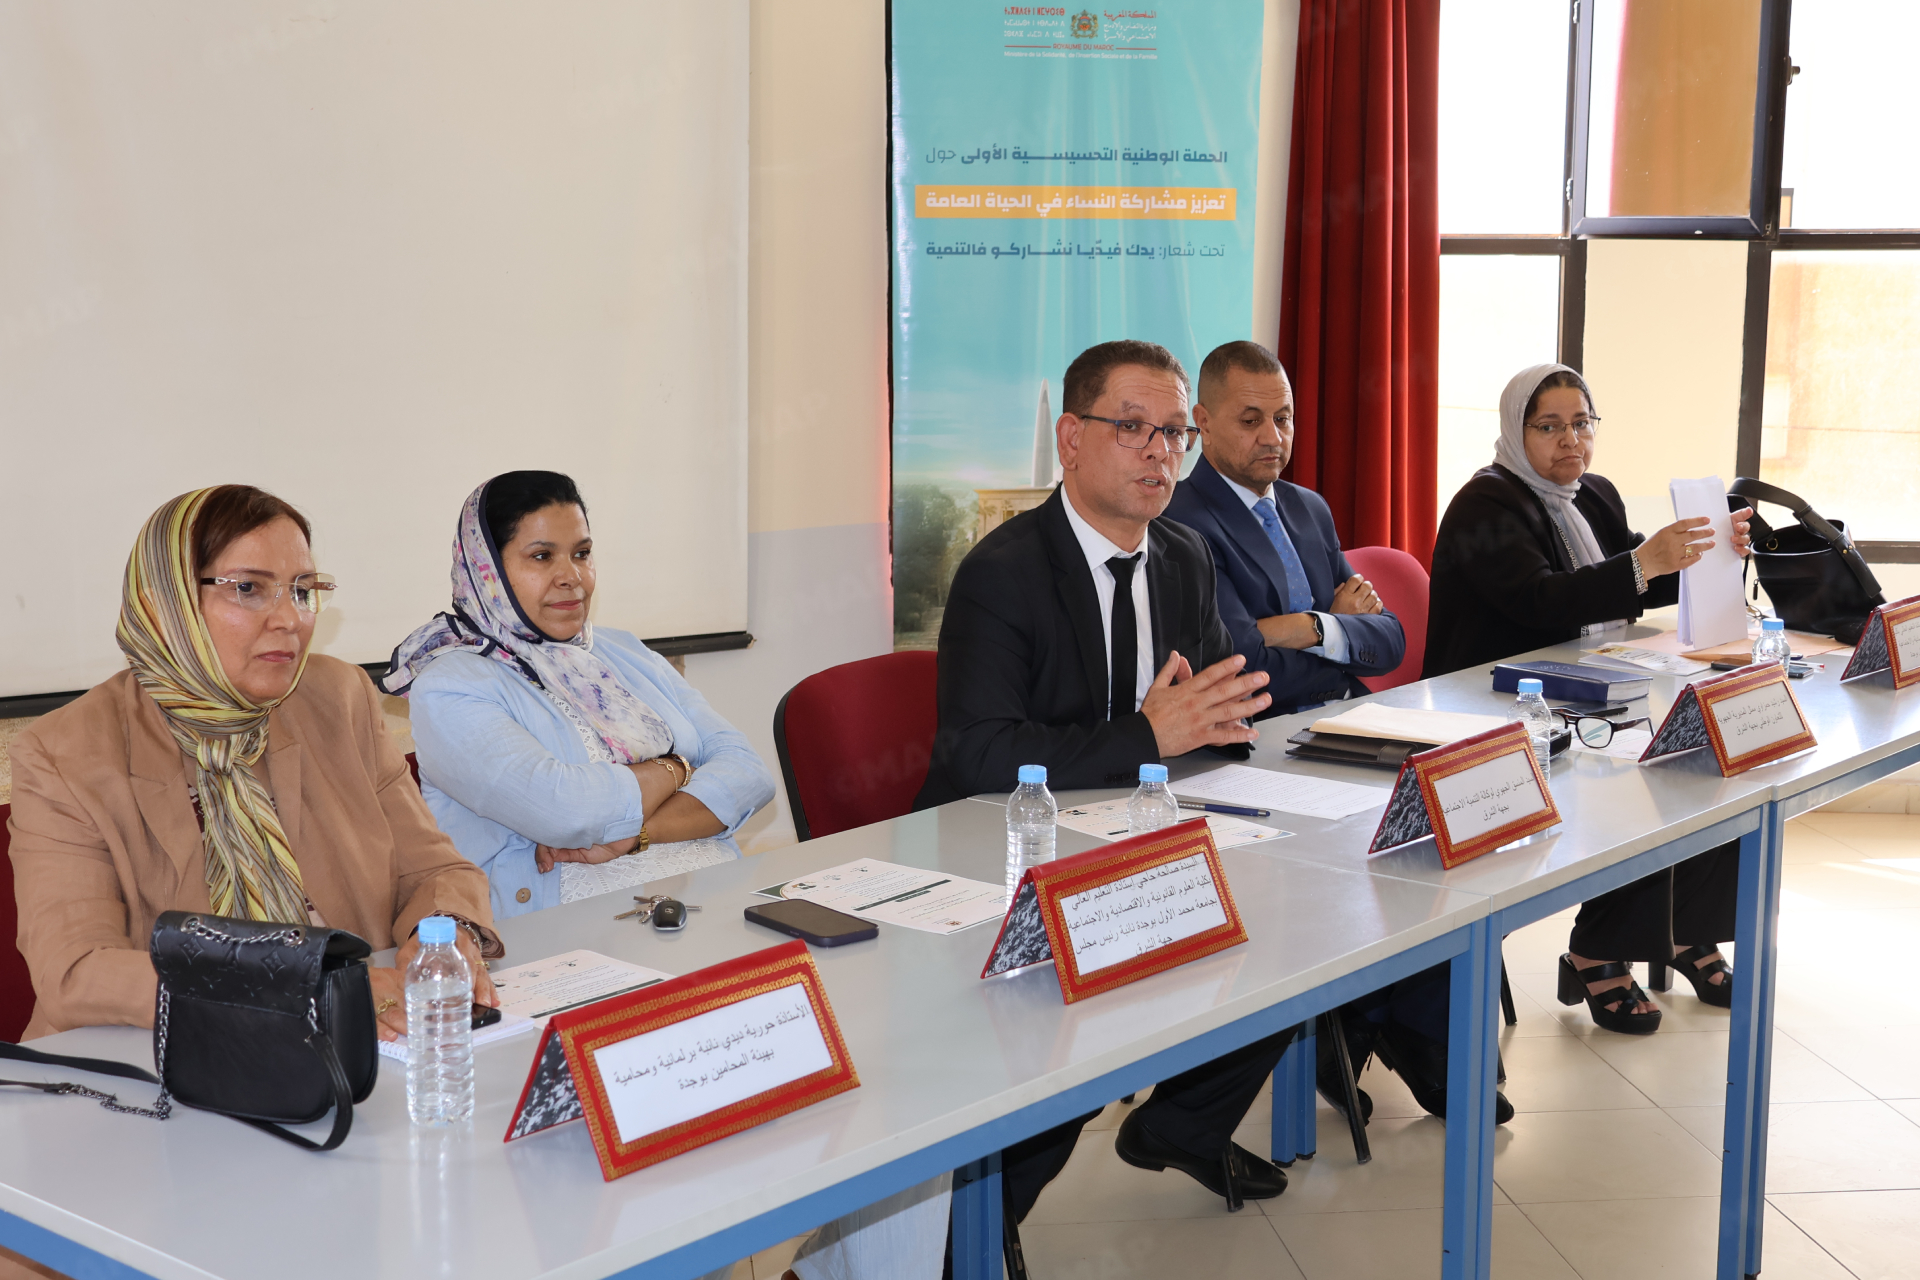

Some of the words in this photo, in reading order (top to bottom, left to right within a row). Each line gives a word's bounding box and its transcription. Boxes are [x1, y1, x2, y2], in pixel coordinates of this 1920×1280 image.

[1103, 9, 1128, 22] المغربية
[1128, 9, 1157, 19] المملكة
[925, 145, 957, 164] حول
[961, 142, 1008, 165] الأولى
[1122, 146, 1179, 166] الوطنية
[1183, 147, 1228, 164] الحملة
[925, 192, 981, 208] العامة
[984, 191, 1032, 213] الحياة
[1036, 193, 1063, 217] في
[1065, 195, 1116, 210] النساء
[1119, 189, 1187, 214] مشاركة
[1190, 194, 1227, 215] تعزيز
[925, 241, 987, 260] فالتنمية
[1125, 243, 1155, 260] يدك
[1158, 240, 1195, 260] شعار:
[1199, 243, 1226, 258] تحت
[1495, 781, 1511, 799] الجهوي
[1482, 805, 1498, 822] الشرق
[1497, 804, 1510, 815] بجهة
[1156, 864, 1179, 878] صالحة
[1179, 856, 1199, 872] السيدة
[1137, 871, 1156, 889] حاجي
[1178, 879, 1196, 898] العلوم
[1196, 873, 1212, 889] بكلية
[1071, 890, 1091, 911] العالي
[1093, 882, 1113, 903] التعليم
[1151, 884, 1177, 903] القانونية
[1110, 895, 1151, 917] والاقتصادية
[1178, 905, 1195, 917] محمد
[1195, 896, 1218, 910] بجامعة
[1068, 909, 1110, 933] والاجتماعية
[1136, 918, 1157, 931] بوجدة
[1158, 907, 1176, 925] الأول
[1099, 929, 1119, 948] رئيس
[1119, 922, 1136, 937] نائبة
[1075, 937, 1097, 956] مجلس
[1136, 936, 1157, 956] الشرق
[1158, 934, 1173, 947] جهة
[775, 1002, 810, 1026] الأستاذة
[744, 1022, 776, 1039] حورية
[696, 1037, 720, 1056] نائبة
[721, 1030, 745, 1052] ديدي
[657, 1048, 697, 1071] برلمانية
[750, 1048, 775, 1063] بهيئة
[711, 1053, 749, 1082] المحامين
[677, 1074, 708, 1091] بوجدة
